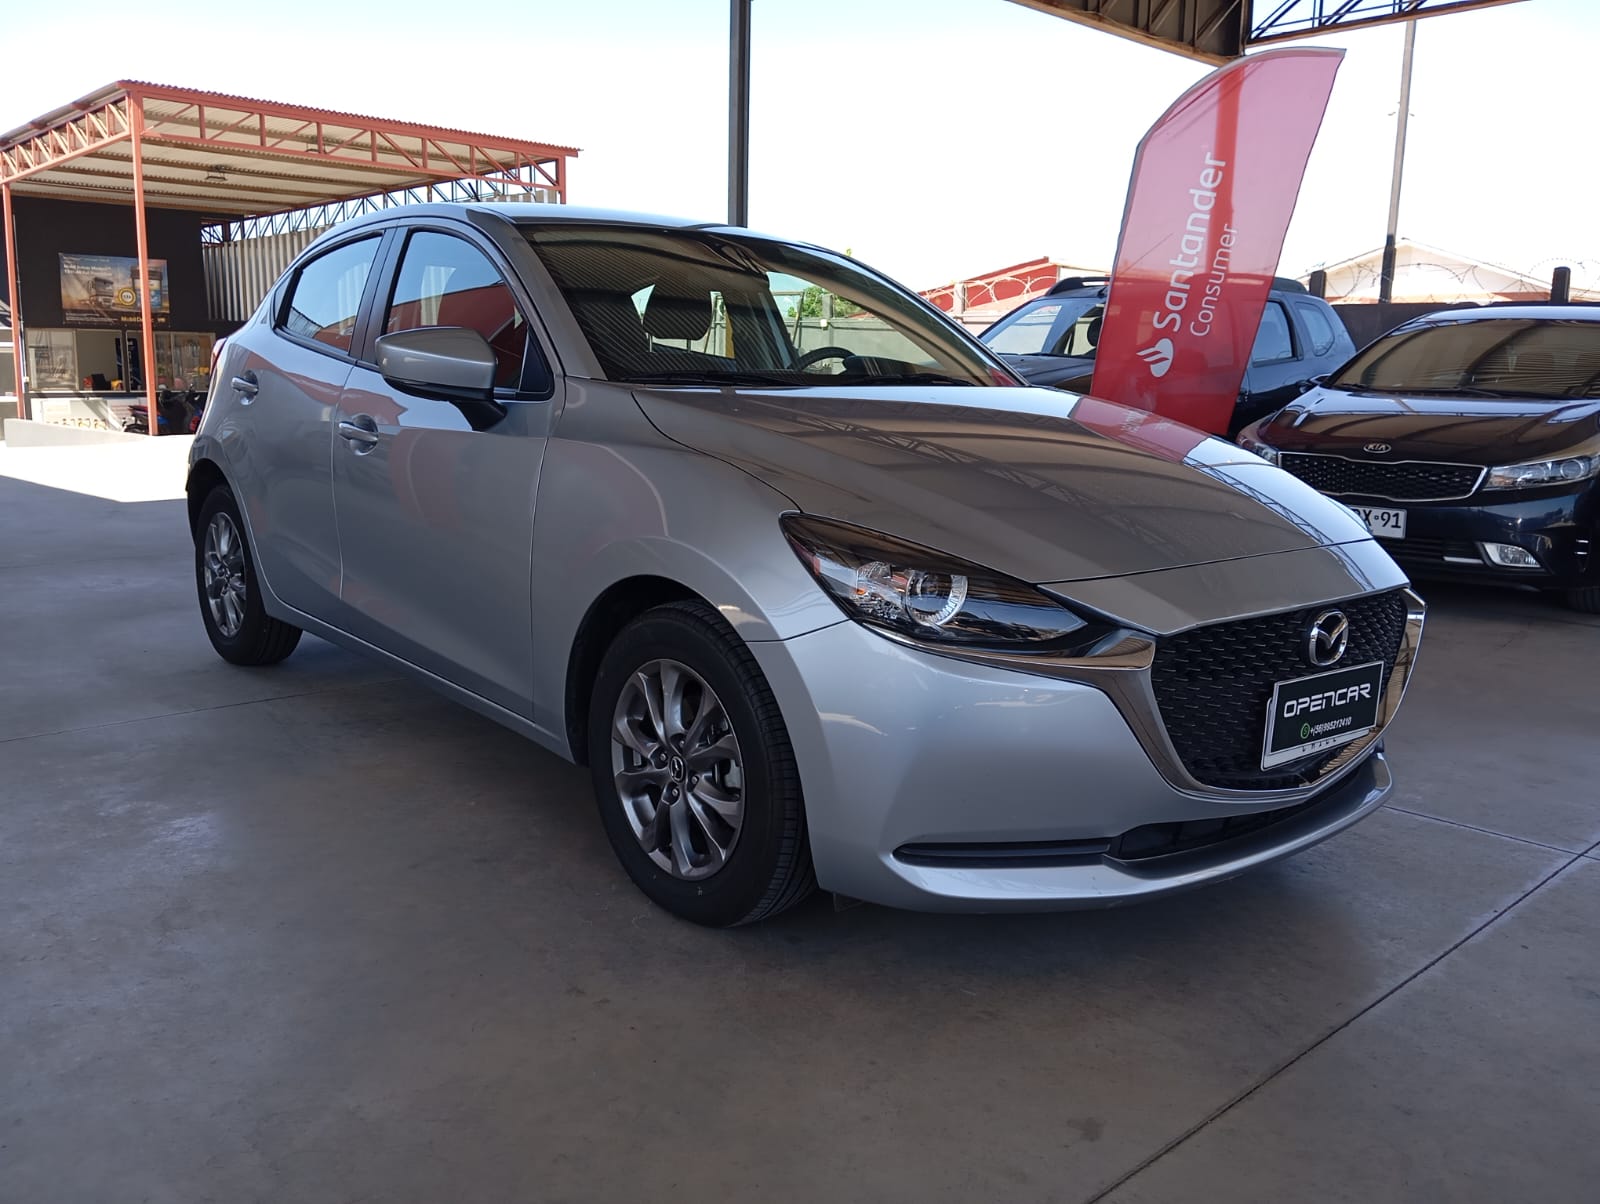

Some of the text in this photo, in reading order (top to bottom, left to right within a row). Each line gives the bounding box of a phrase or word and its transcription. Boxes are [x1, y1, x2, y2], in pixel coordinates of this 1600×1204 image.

[1152, 152, 1227, 332] Santander
[1189, 223, 1239, 337] Consumer
[1283, 683, 1372, 718] OPENCAR
